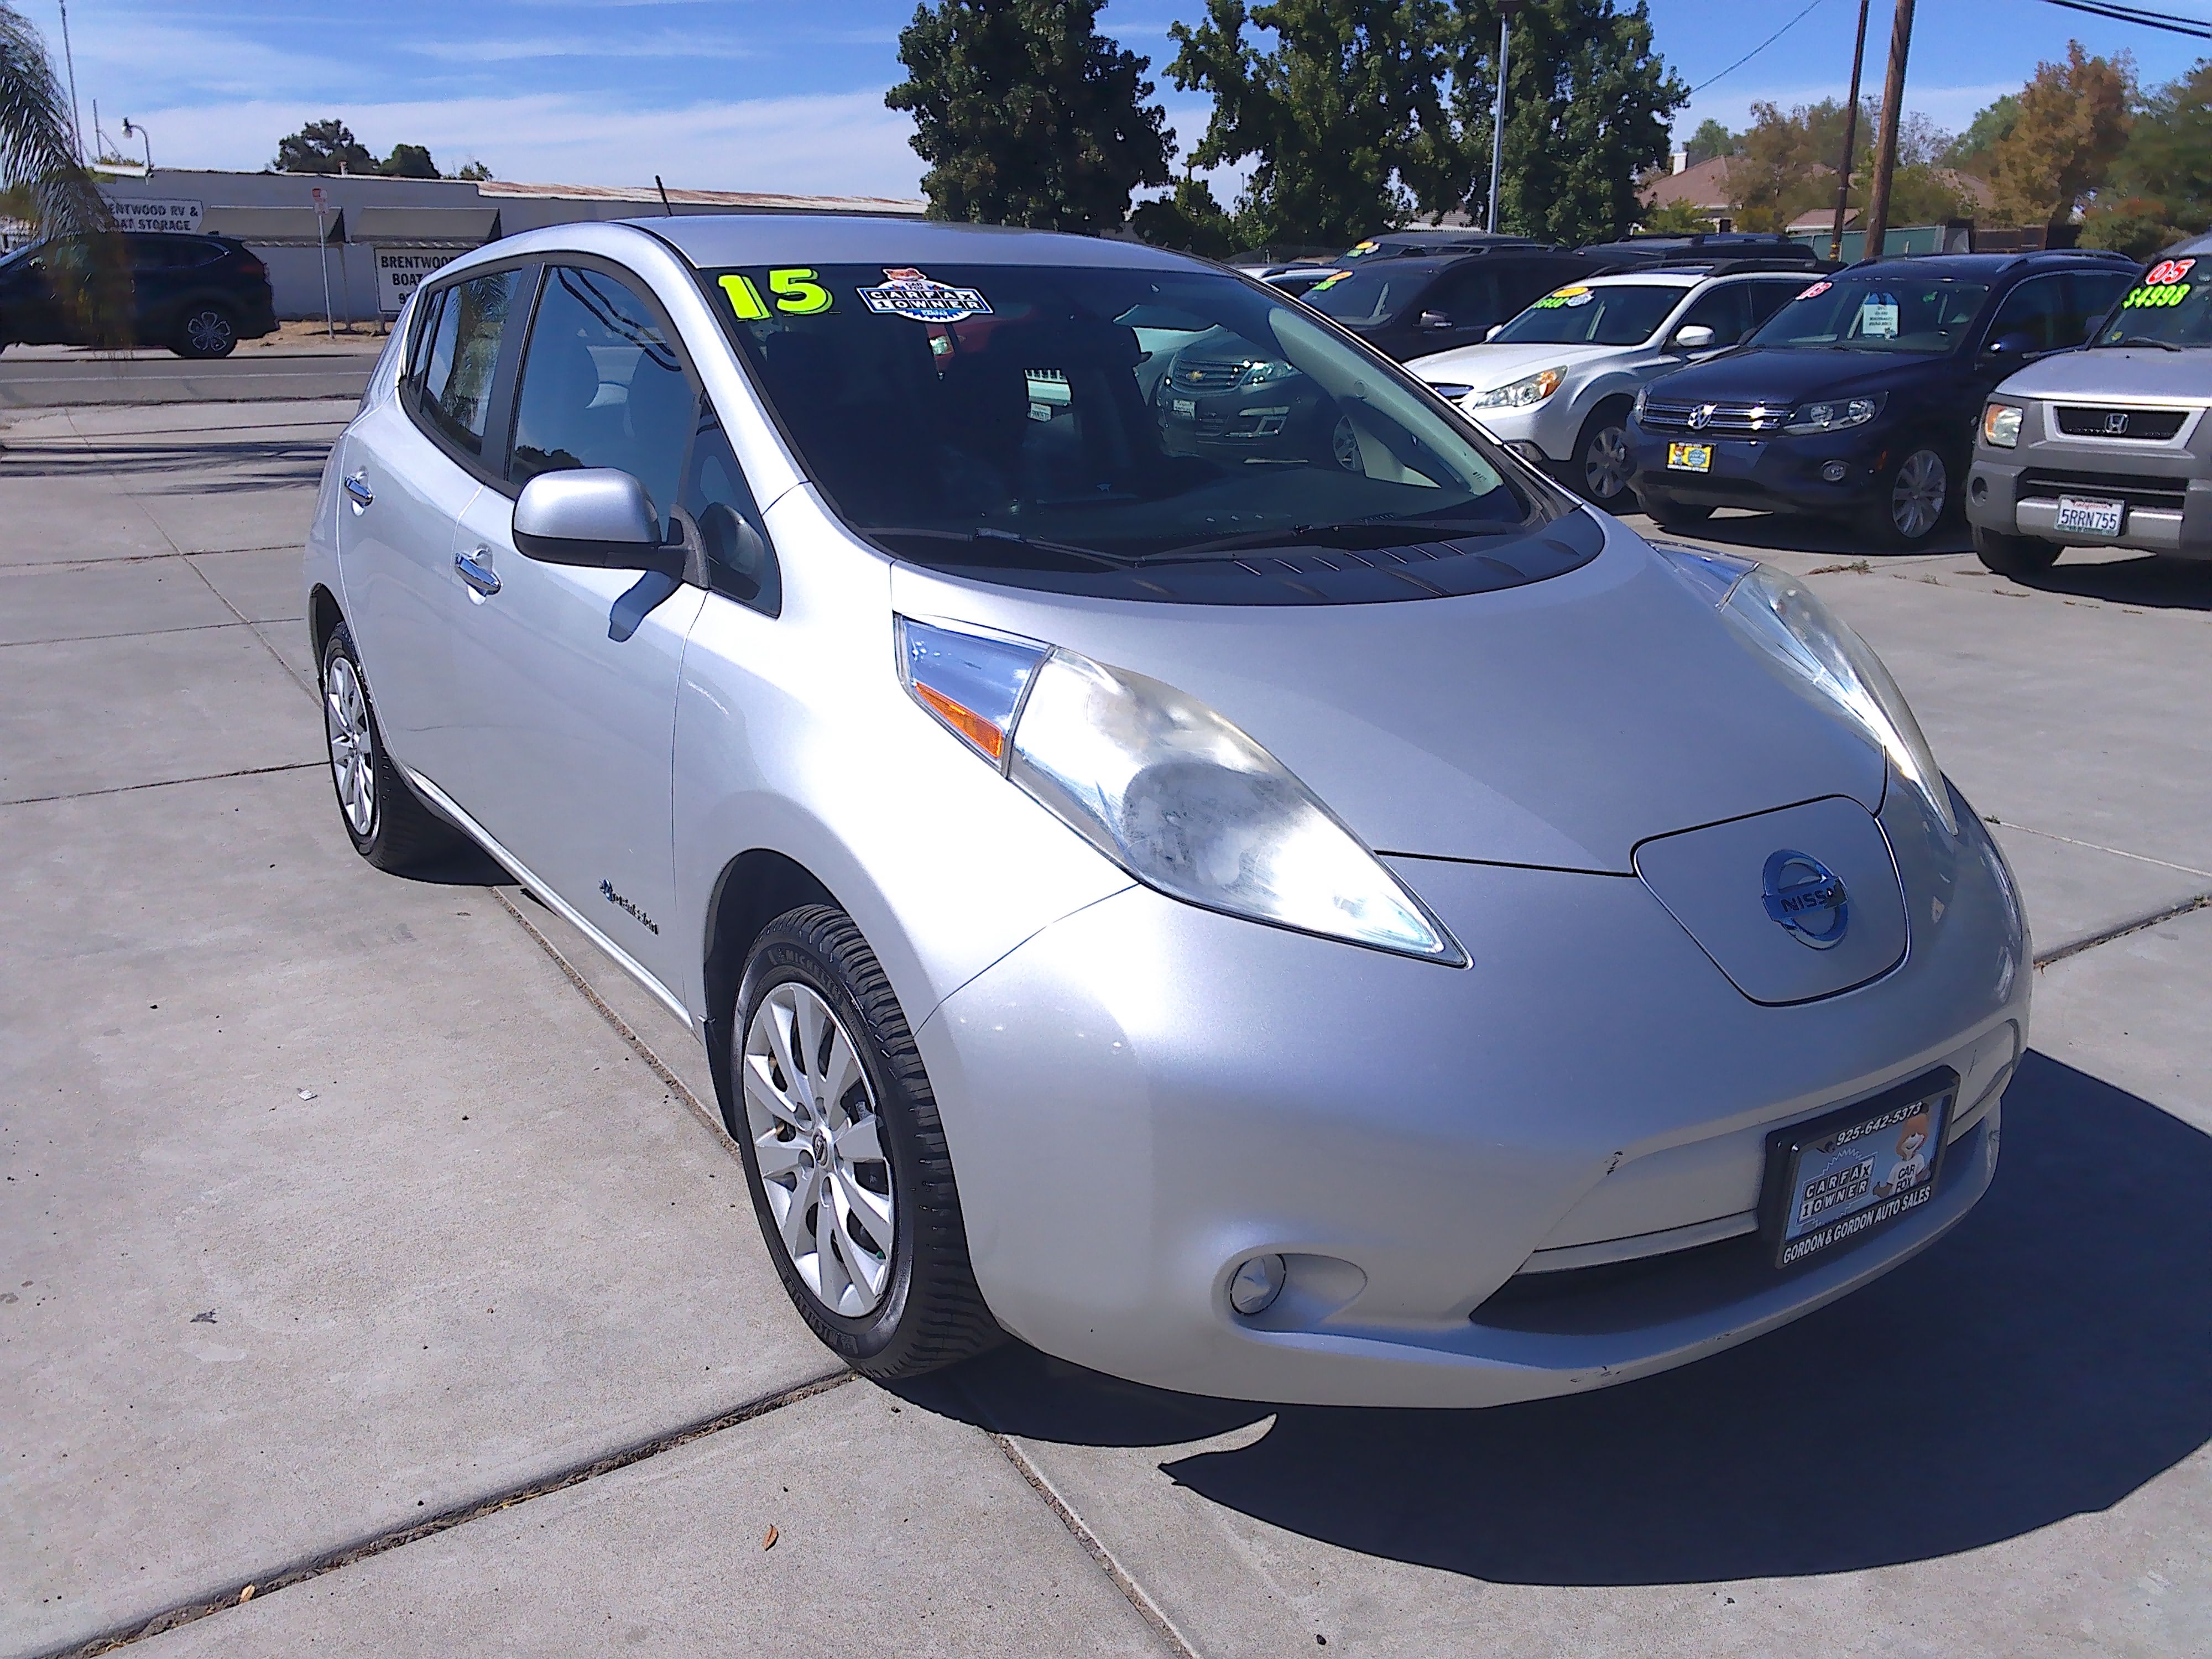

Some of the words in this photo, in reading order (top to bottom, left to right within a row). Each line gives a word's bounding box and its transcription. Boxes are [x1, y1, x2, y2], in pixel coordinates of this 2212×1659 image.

[110, 204, 166, 216] ENTWOOD
[170, 205, 185, 216] RV
[190, 207, 198, 217] &
[138, 219, 191, 231] STORAGE
[380, 256, 456, 269] BRENTWOO
[392, 273, 423, 286] BOAT
[2145, 259, 2197, 285] 05
[717, 268, 834, 320] 15
[870, 291, 974, 301] CARFAX
[2122, 283, 2190, 309] $4998
[895, 300, 980, 309] OWNER
[2060, 509, 2117, 529] 5RRN755
[1837, 1101, 1923, 1146] 925-642-5373
[1806, 1162, 1872, 1199] CARFAX
[1898, 1164, 1916, 1179] CAR
[1895, 1176, 1912, 1193] FOX
[1814, 1180, 1868, 1212] OWNER
[1783, 1232, 1825, 1264] GORDON
[1825, 1228, 1833, 1245] &
[1834, 1209, 1875, 1241] GORDON
[1874, 1197, 1900, 1223] AUTO
[1901, 1186, 1931, 1212] SALES
